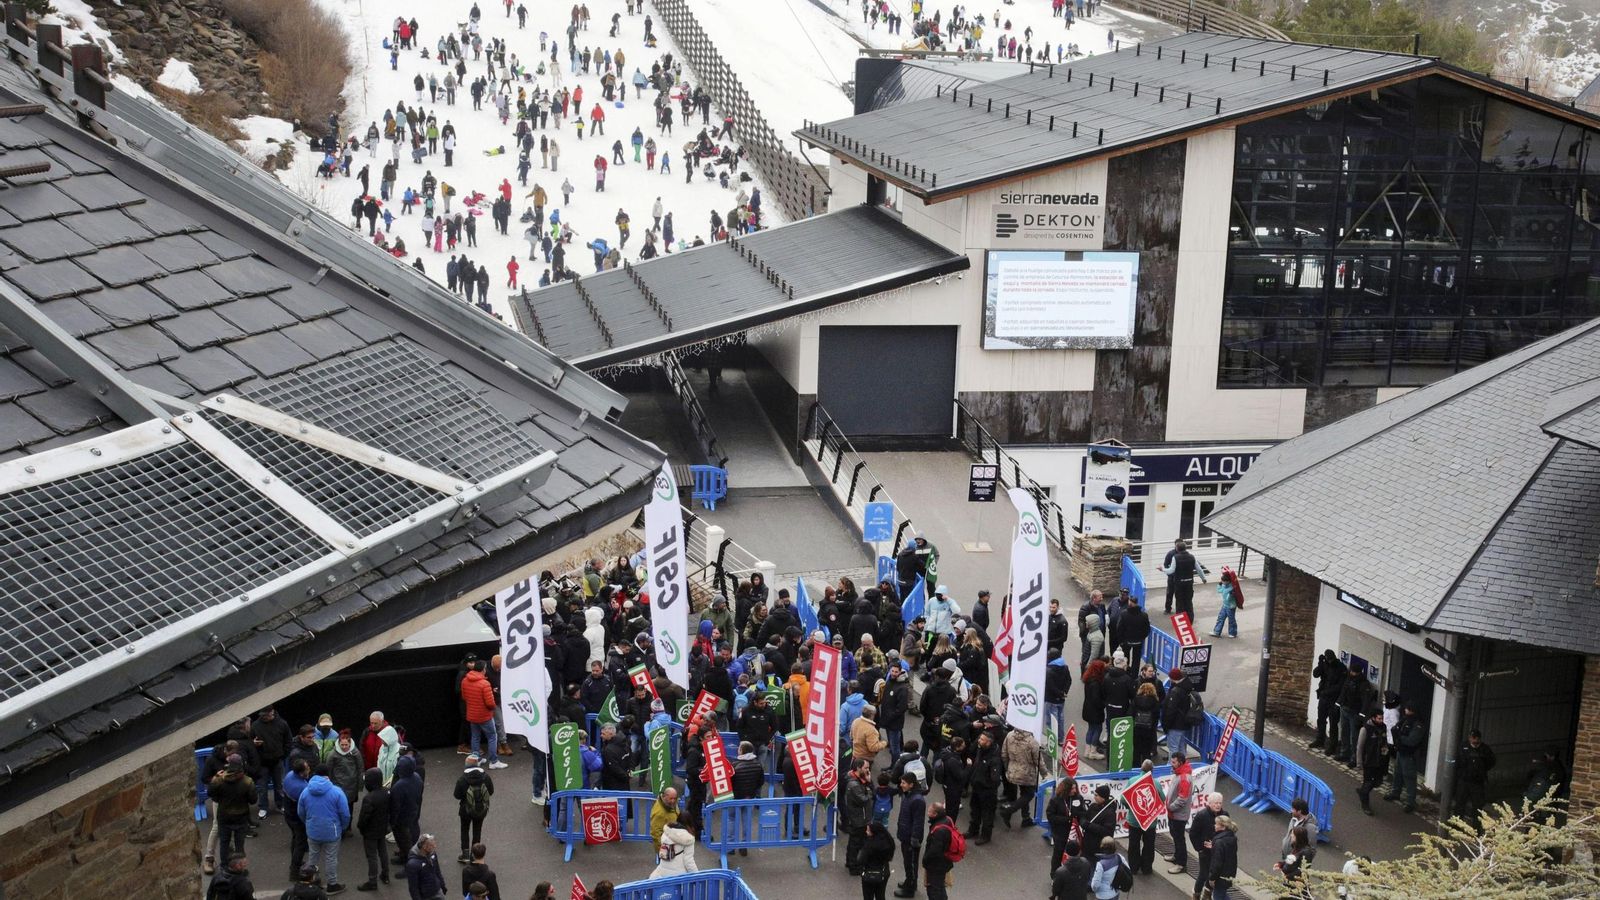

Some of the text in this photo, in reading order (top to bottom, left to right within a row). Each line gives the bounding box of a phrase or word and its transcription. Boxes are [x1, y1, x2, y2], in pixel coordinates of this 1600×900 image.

[1000, 191, 1099, 205] sierranevada
[1024, 214, 1095, 227] DEKTON
[1185, 456, 1253, 479] ALQU
[1174, 614, 1194, 646] CCO
[558, 730, 576, 740] CSIF
[1215, 713, 1237, 762] CCOO
[562, 746, 573, 788] CSIF
[657, 749, 666, 792] CSIF
[706, 739, 729, 795] CCOO
[791, 738, 816, 793] CCOO
[590, 816, 602, 838] UGT
